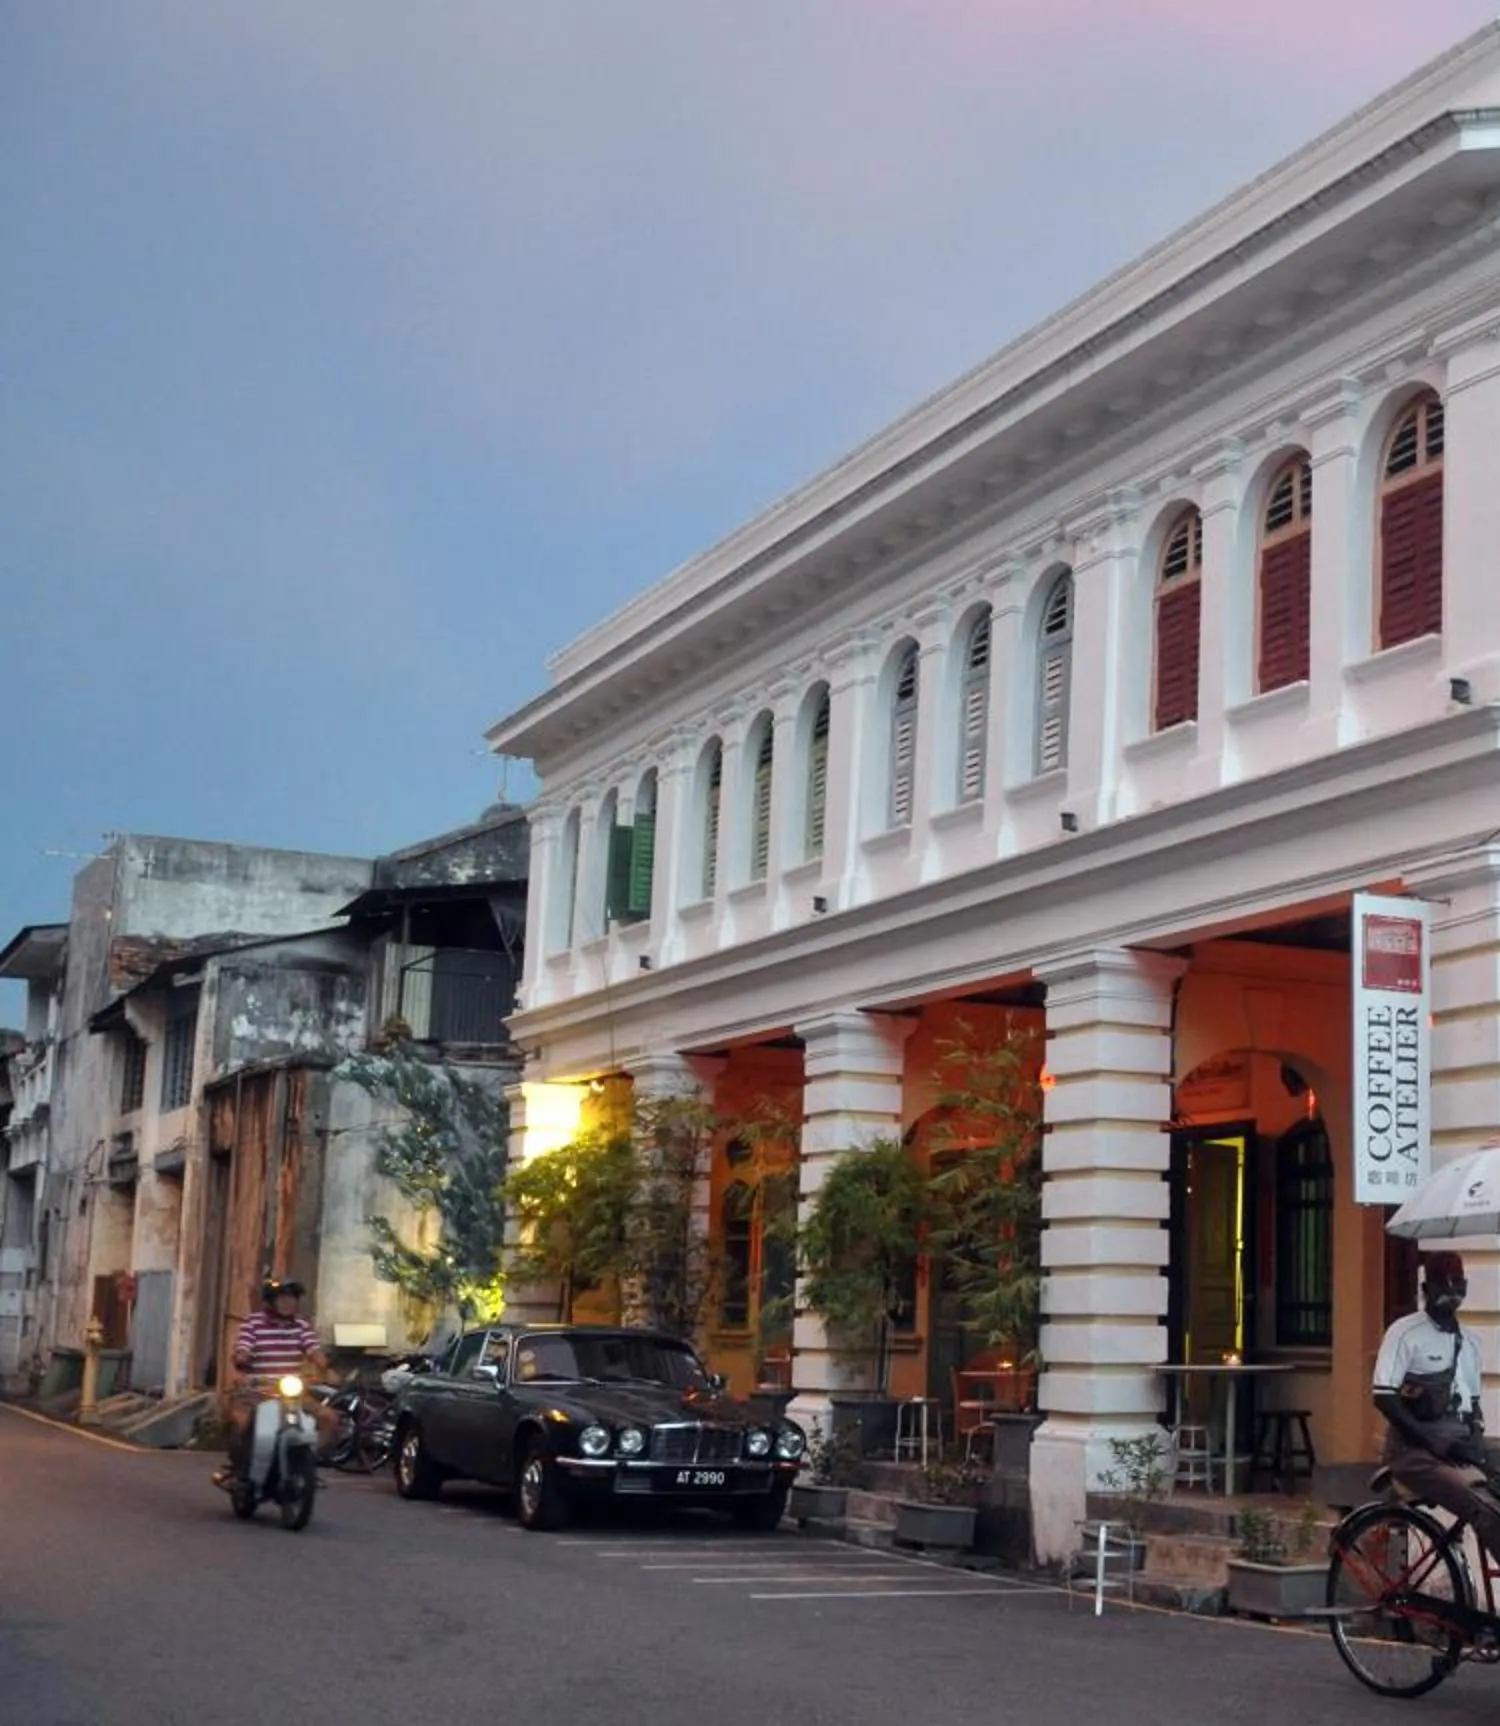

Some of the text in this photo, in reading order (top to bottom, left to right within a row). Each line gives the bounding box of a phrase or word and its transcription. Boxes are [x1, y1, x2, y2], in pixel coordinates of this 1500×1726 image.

[1367, 1005, 1393, 1162] COFFEE
[1396, 1007, 1419, 1166] ATELIER
[676, 1471, 725, 1485] AT 2990
